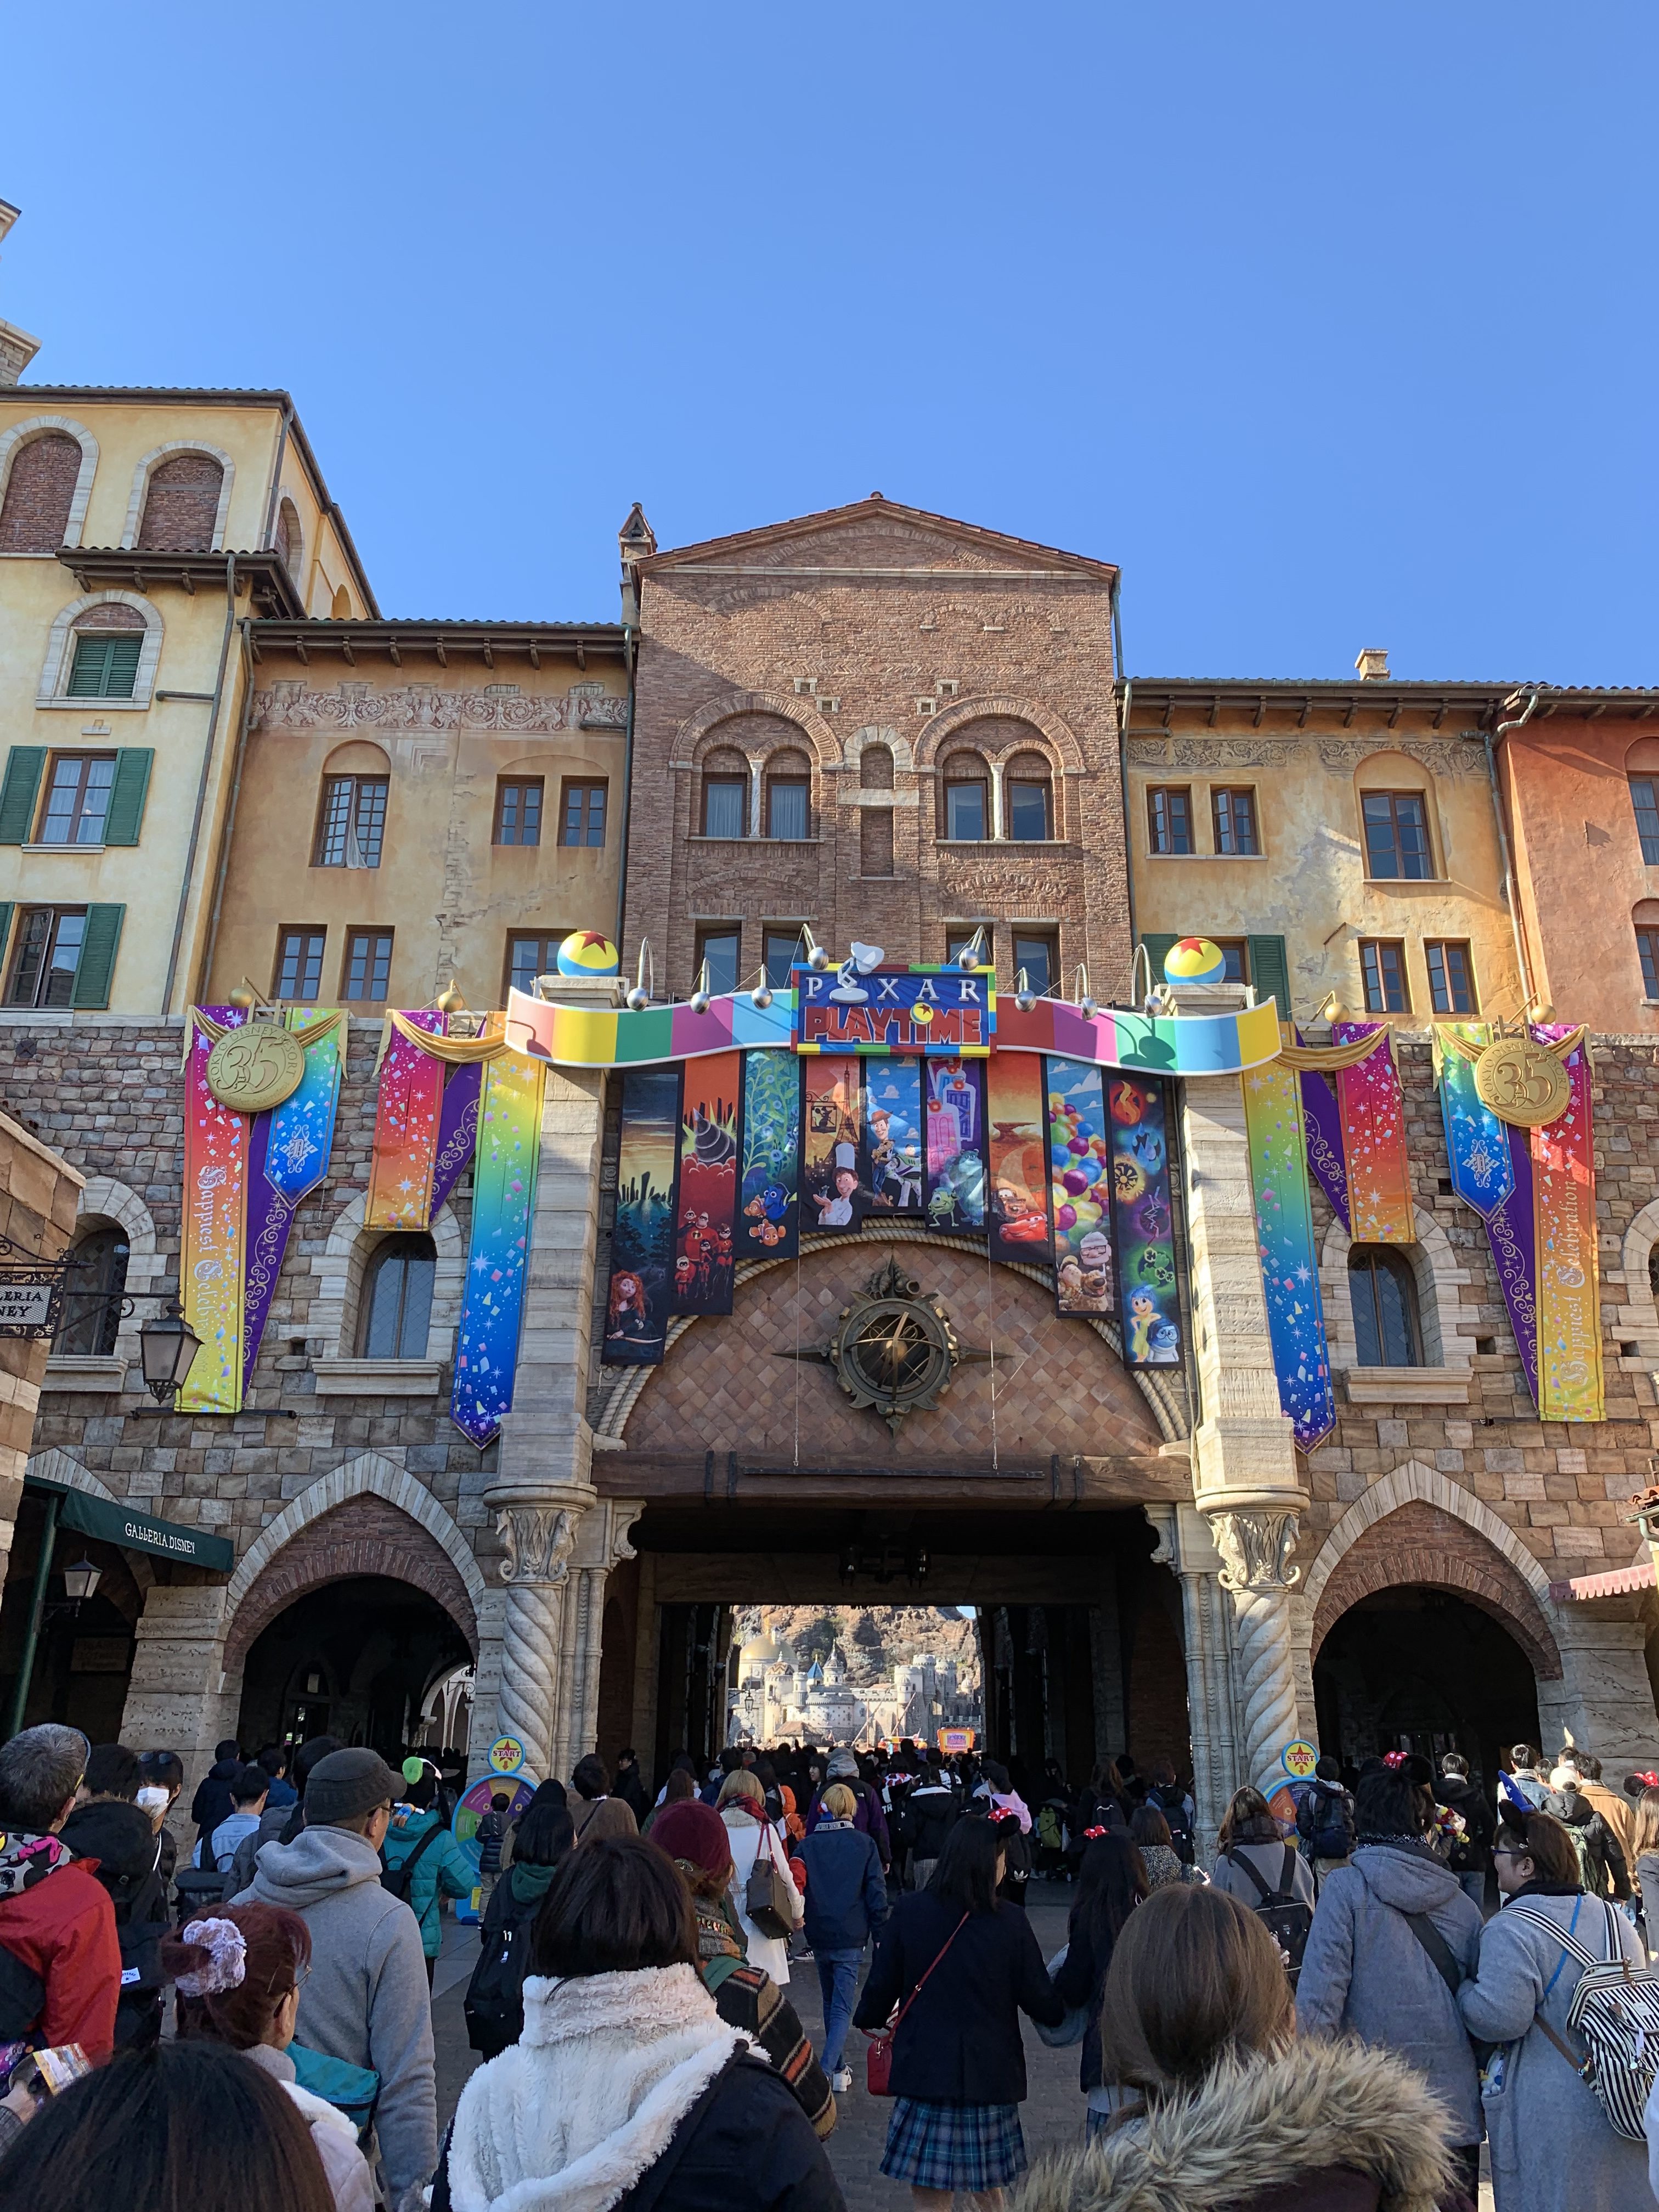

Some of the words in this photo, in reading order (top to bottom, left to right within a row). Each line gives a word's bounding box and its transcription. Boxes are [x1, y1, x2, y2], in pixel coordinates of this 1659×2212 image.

[805, 977, 980, 1003] PXAR
[804, 1006, 981, 1045] PLAYTIME
[210, 1042, 228, 1085] TOKYO
[229, 1026, 278, 1042] DISNEY
[278, 1034, 298, 1078] RESORT
[1482, 1059, 1497, 1101] TOKYO
[1492, 1042, 1537, 1058] DISNEY
[1542, 1049, 1567, 1093] RESORT
[194, 1165, 227, 1253] Happiest
[1556, 1180, 1585, 1288] Celebration
[1560, 1296, 1591, 1386] Happiest
[125, 1522, 168, 1548] GALLERIA
[168, 1535, 195, 1554] DISNEY
